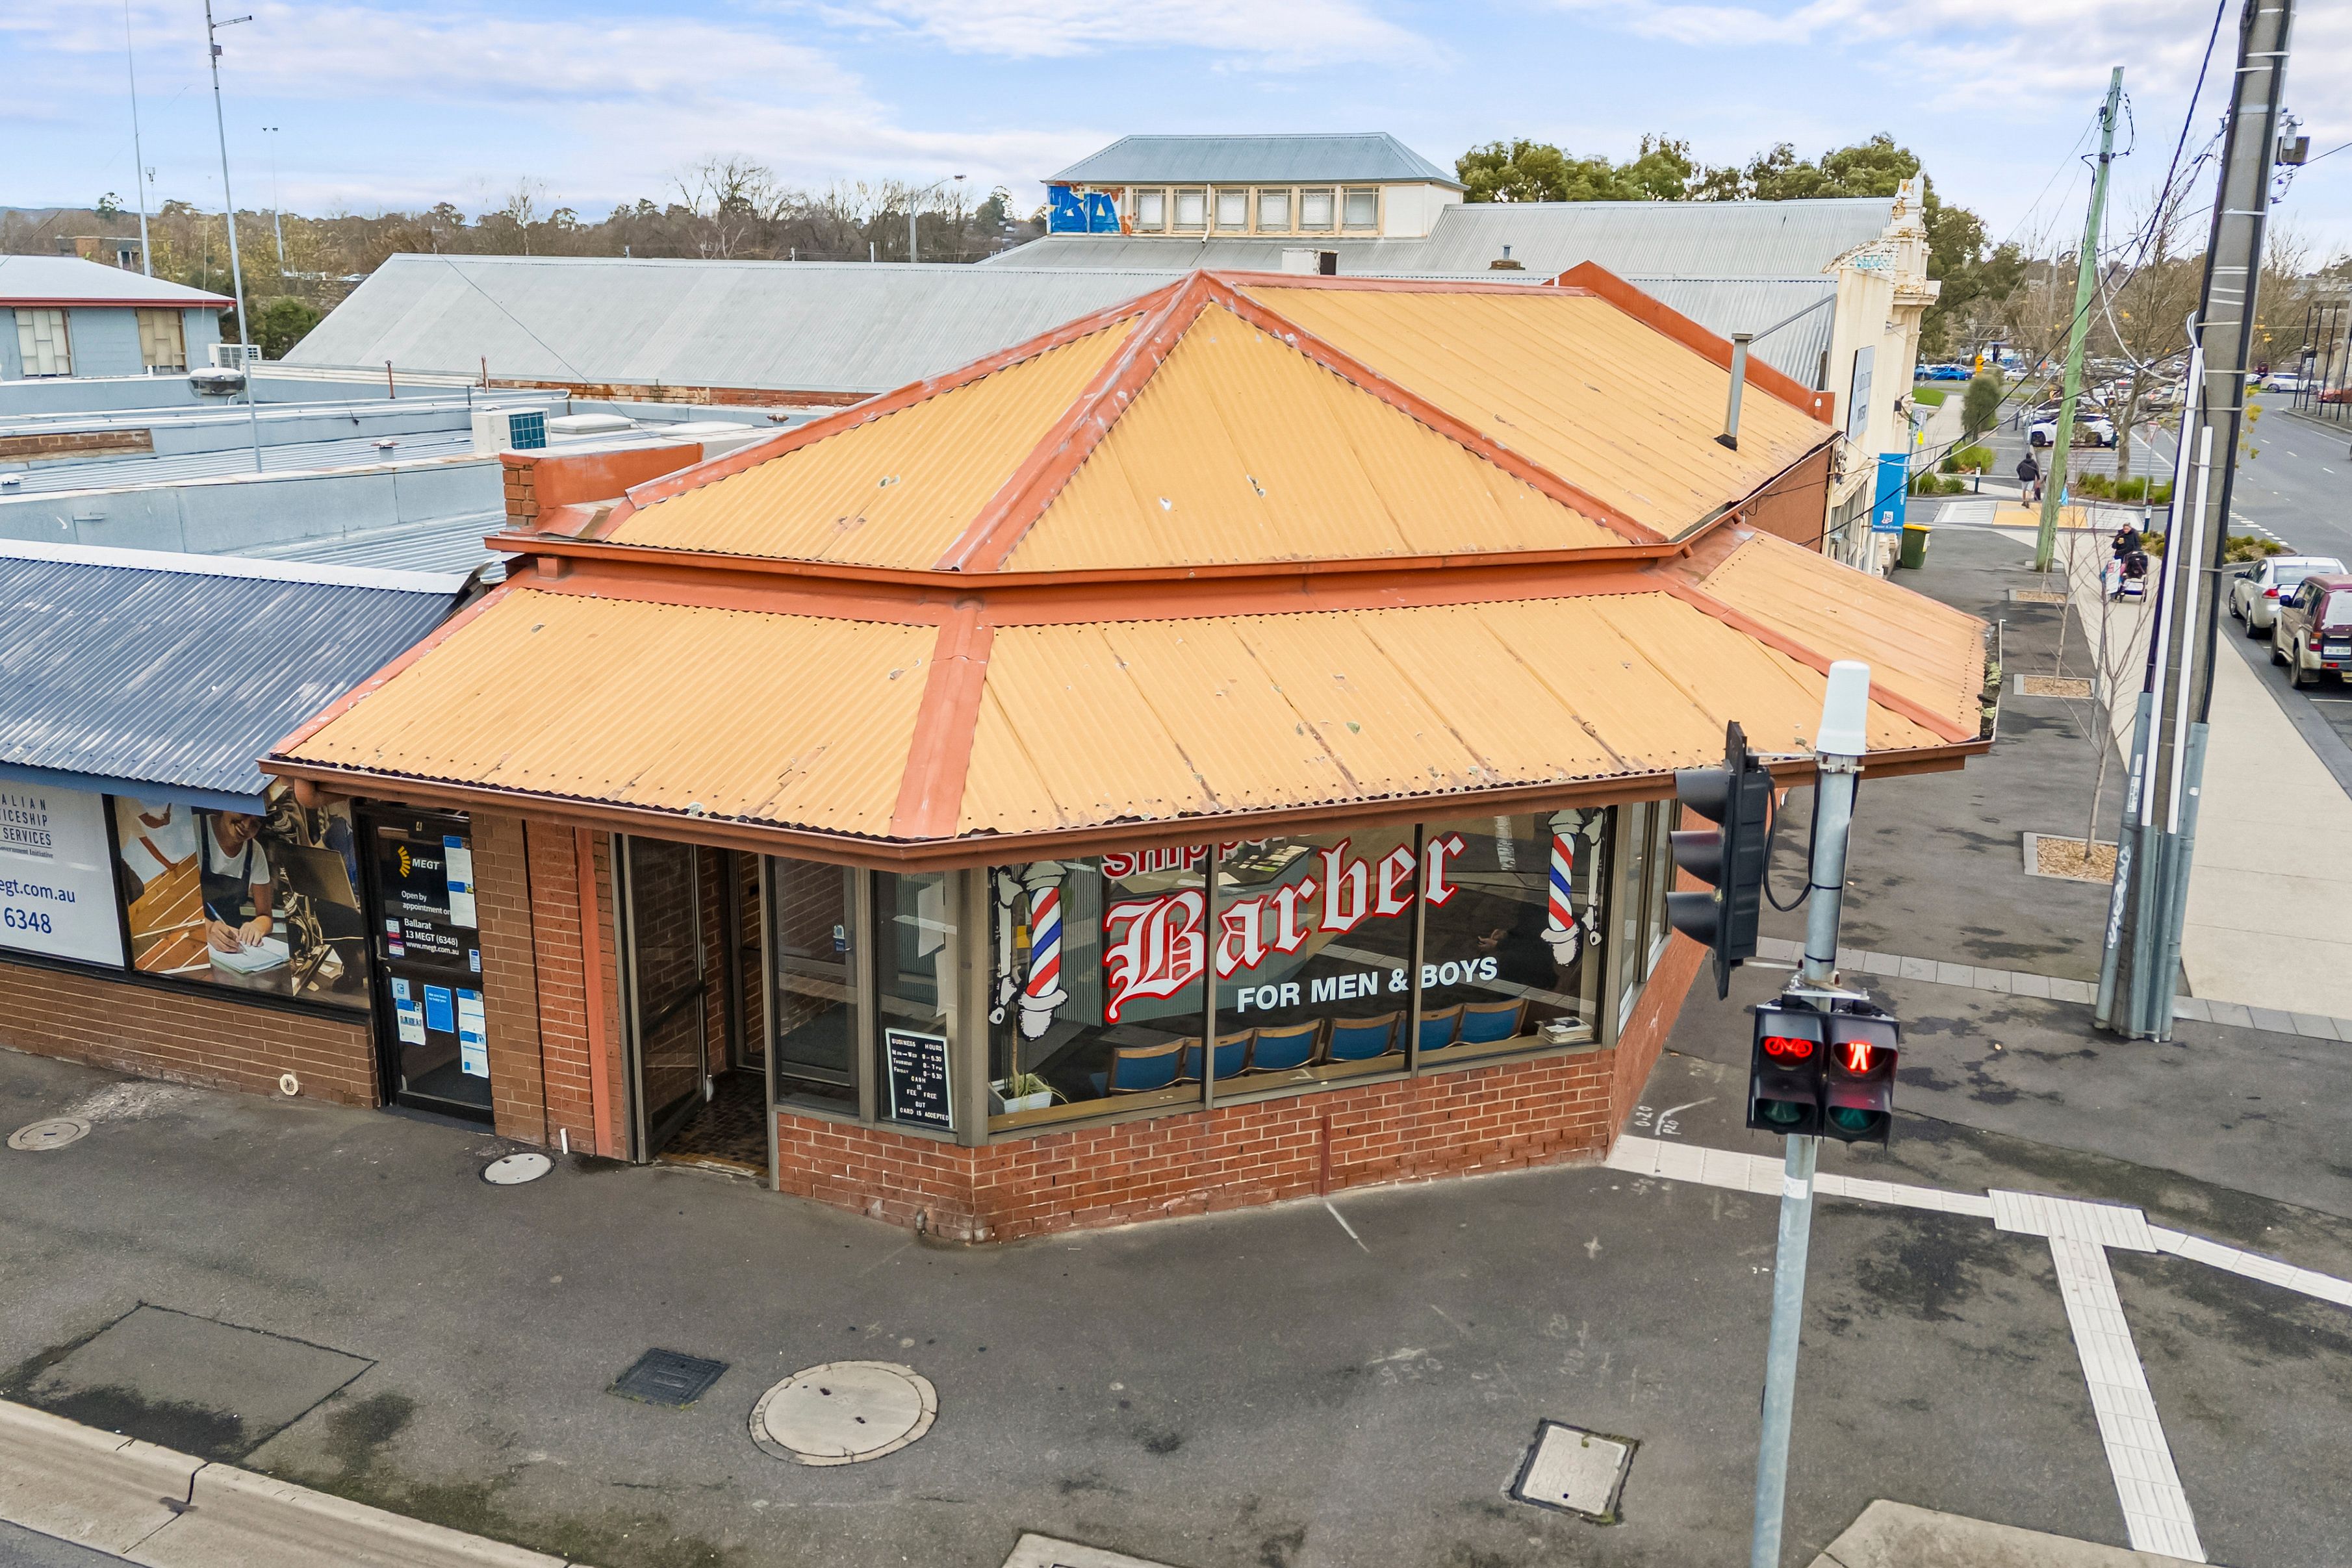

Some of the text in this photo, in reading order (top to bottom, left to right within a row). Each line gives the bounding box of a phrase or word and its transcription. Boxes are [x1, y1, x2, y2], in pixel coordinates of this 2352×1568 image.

[416, 821, 422, 831] 4
[3, 828, 51, 846] SERVICES
[412, 858, 440, 870] MEGT
[0, 879, 75, 903] egt.com.au
[401, 891, 427, 902] Open by
[403, 902, 442, 915] appointment
[4, 907, 52, 934] 6348
[403, 918, 432, 930] Ballarat
[1102, 832, 1466, 1024] Barber
[405, 930, 458, 948] 13 MEGT (6348)
[406, 941, 459, 955] www.megt.com.au
[1237, 956, 1498, 1013] FOR MEN & BOYS
[925, 1043, 942, 1052] HOURS
[925, 1111, 949, 1121] ACCEPTED
